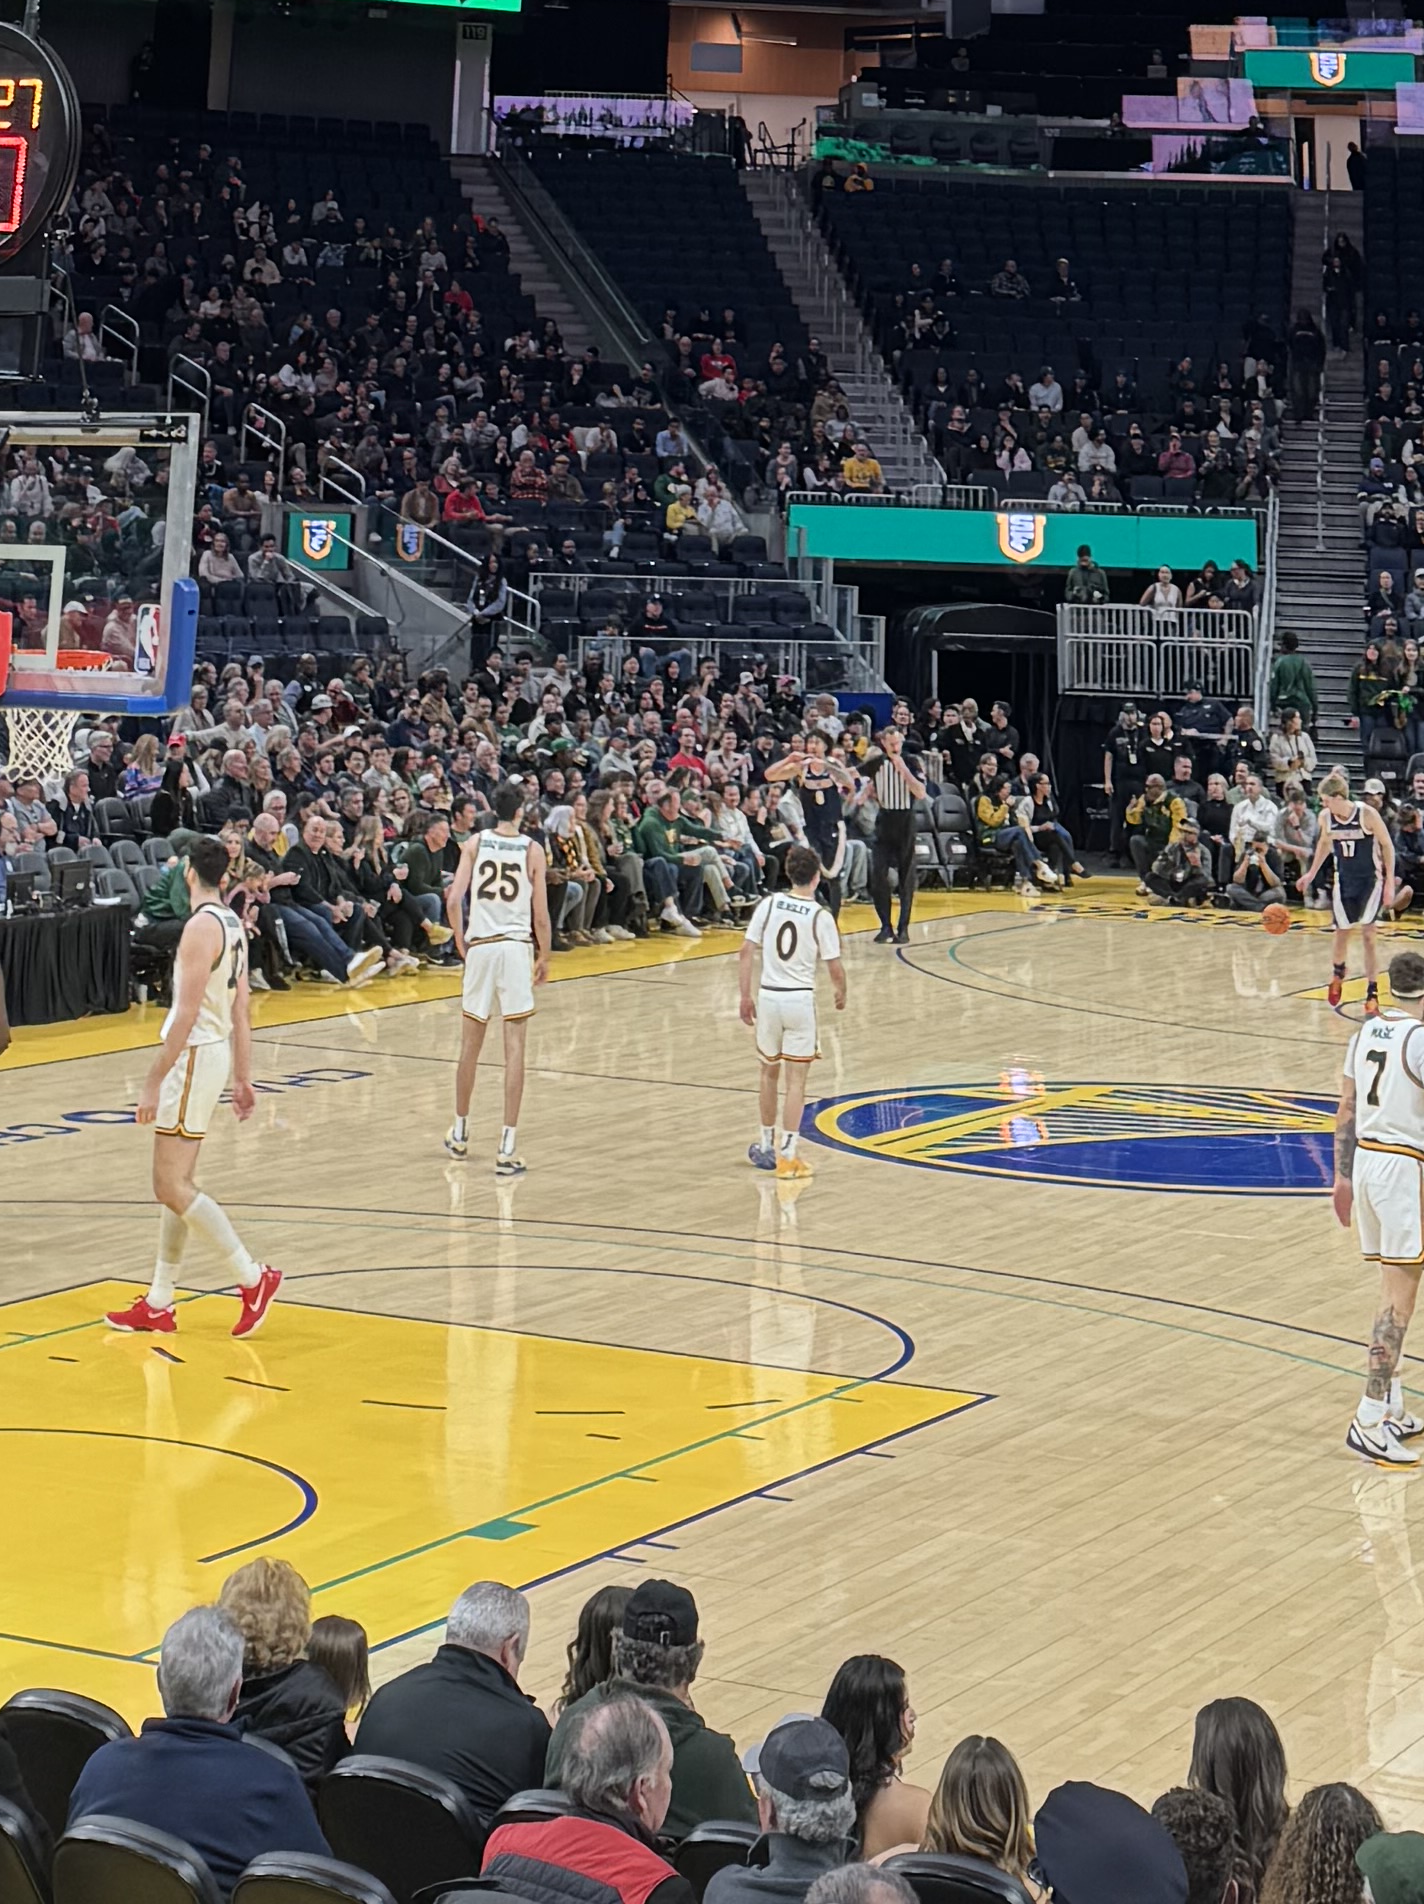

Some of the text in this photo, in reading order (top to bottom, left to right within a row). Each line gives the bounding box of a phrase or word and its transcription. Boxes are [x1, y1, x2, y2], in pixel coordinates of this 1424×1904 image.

[477, 859, 522, 902] 25
[776, 920, 798, 961] 0
[1366, 1049, 1387, 1107] 7
